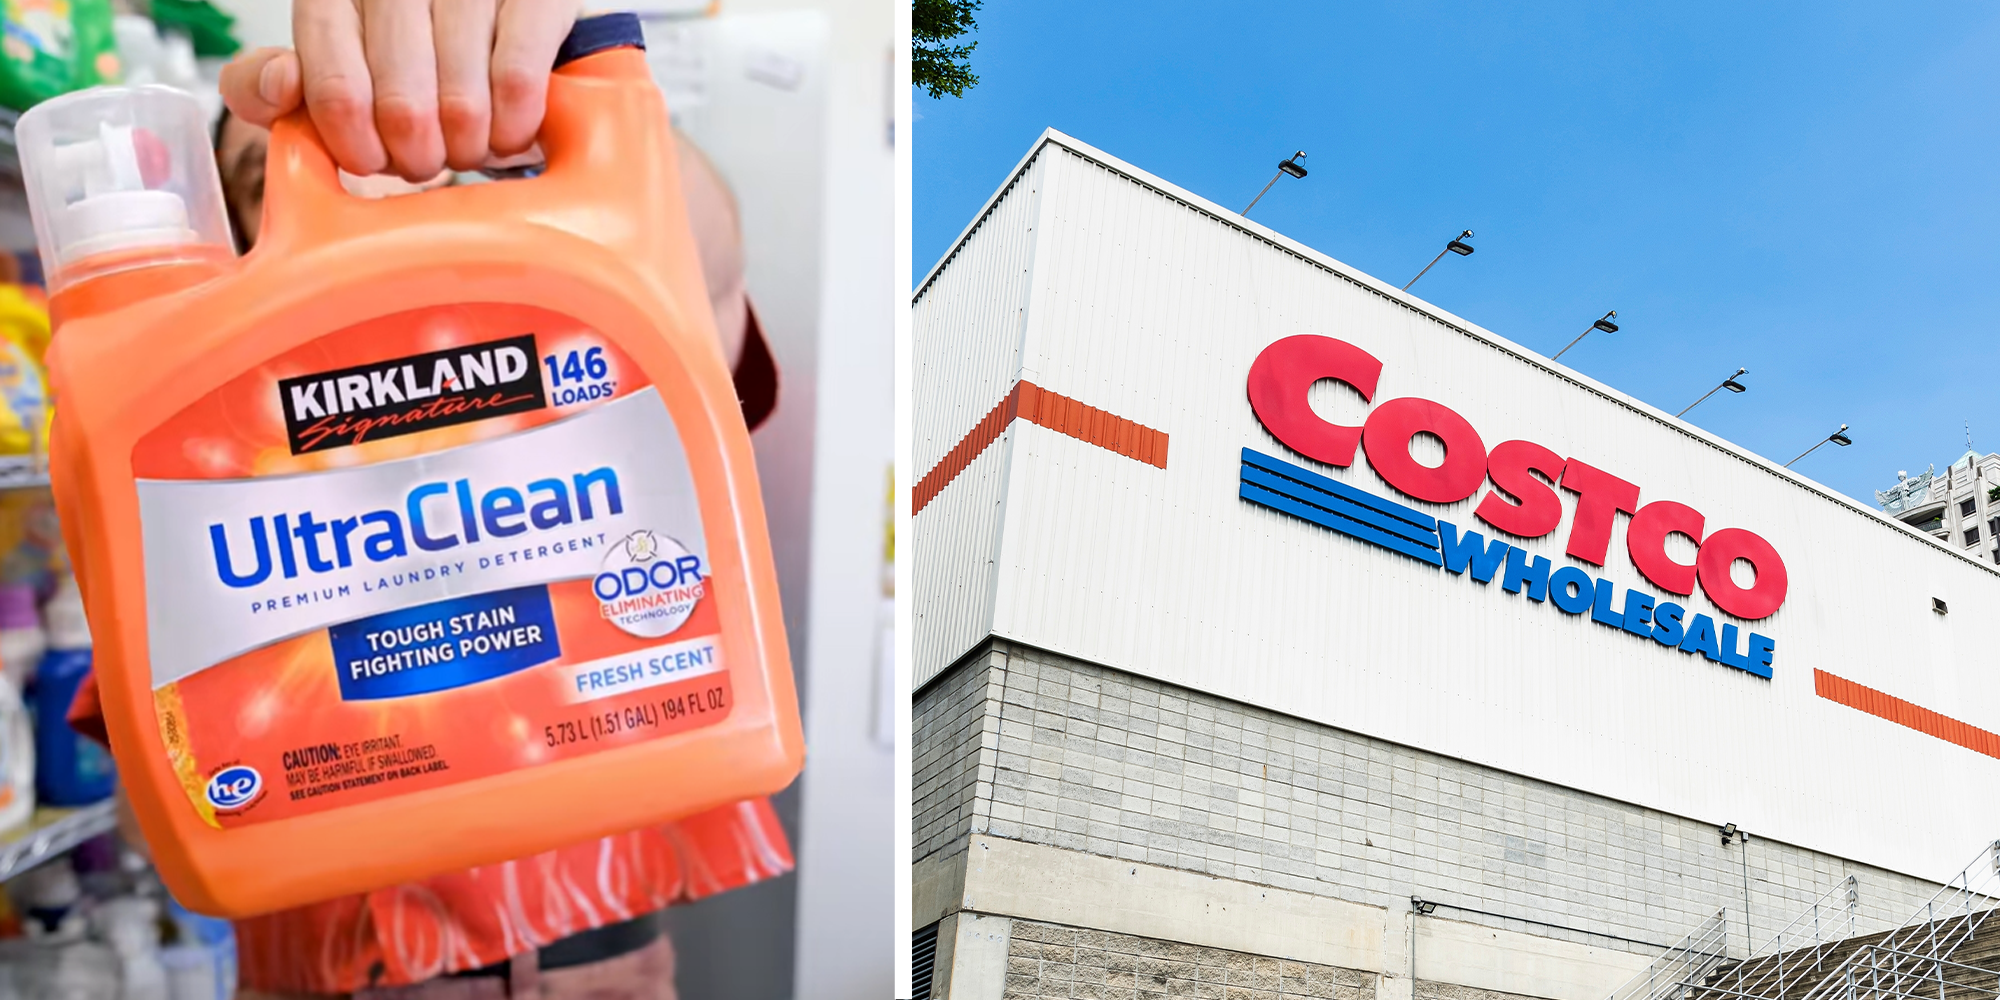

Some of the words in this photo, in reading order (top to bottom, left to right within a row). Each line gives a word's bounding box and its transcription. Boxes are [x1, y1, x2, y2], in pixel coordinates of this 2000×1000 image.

[291, 346, 528, 421] KIRKLAND
[544, 347, 608, 387] 146
[298, 393, 535, 450] Signature
[1247, 334, 1788, 620] COSTCO
[209, 466, 623, 588] UltraClean
[252, 585, 350, 613] PREMIUM
[364, 562, 465, 592] LAUNDRY
[479, 533, 605, 569] DETERGENT
[594, 555, 702, 601] ODOR
[601, 585, 703, 617] ELIMINATING
[620, 603, 691, 625] TECHNOLOGY
[1437, 520, 1775, 679] WHOLESALE
[366, 620, 445, 652] TOUGH
[449, 605, 515, 635] STAIN
[350, 643, 454, 680] FIGHTING
[459, 625, 542, 657] POWER
[576, 662, 644, 693] FRESH
[648, 646, 713, 675] SCENT
[545, 722, 576, 748] 5.73
[578, 719, 588, 740] L
[590, 711, 621, 741] (1.51
[624, 703, 658, 728] GAL)
[662, 697, 686, 720] 194
[688, 693, 706, 714] FL
[707, 687, 725, 709] OZ
[282, 742, 342, 771] CAUTION:
[343, 743, 361, 759] EYE
[286, 771, 307, 788] MAY
[308, 767, 320, 783] BE
[323, 758, 367, 780] HARMFUL
[368, 755, 376, 771] IF
[211, 777, 252, 799] he
[290, 788, 307, 801] SEE
[306, 781, 341, 798] CAUTION
[343, 773, 386, 790] STATEMENT
[387, 771, 399, 782] ON
[400, 767, 421, 780] BACK
